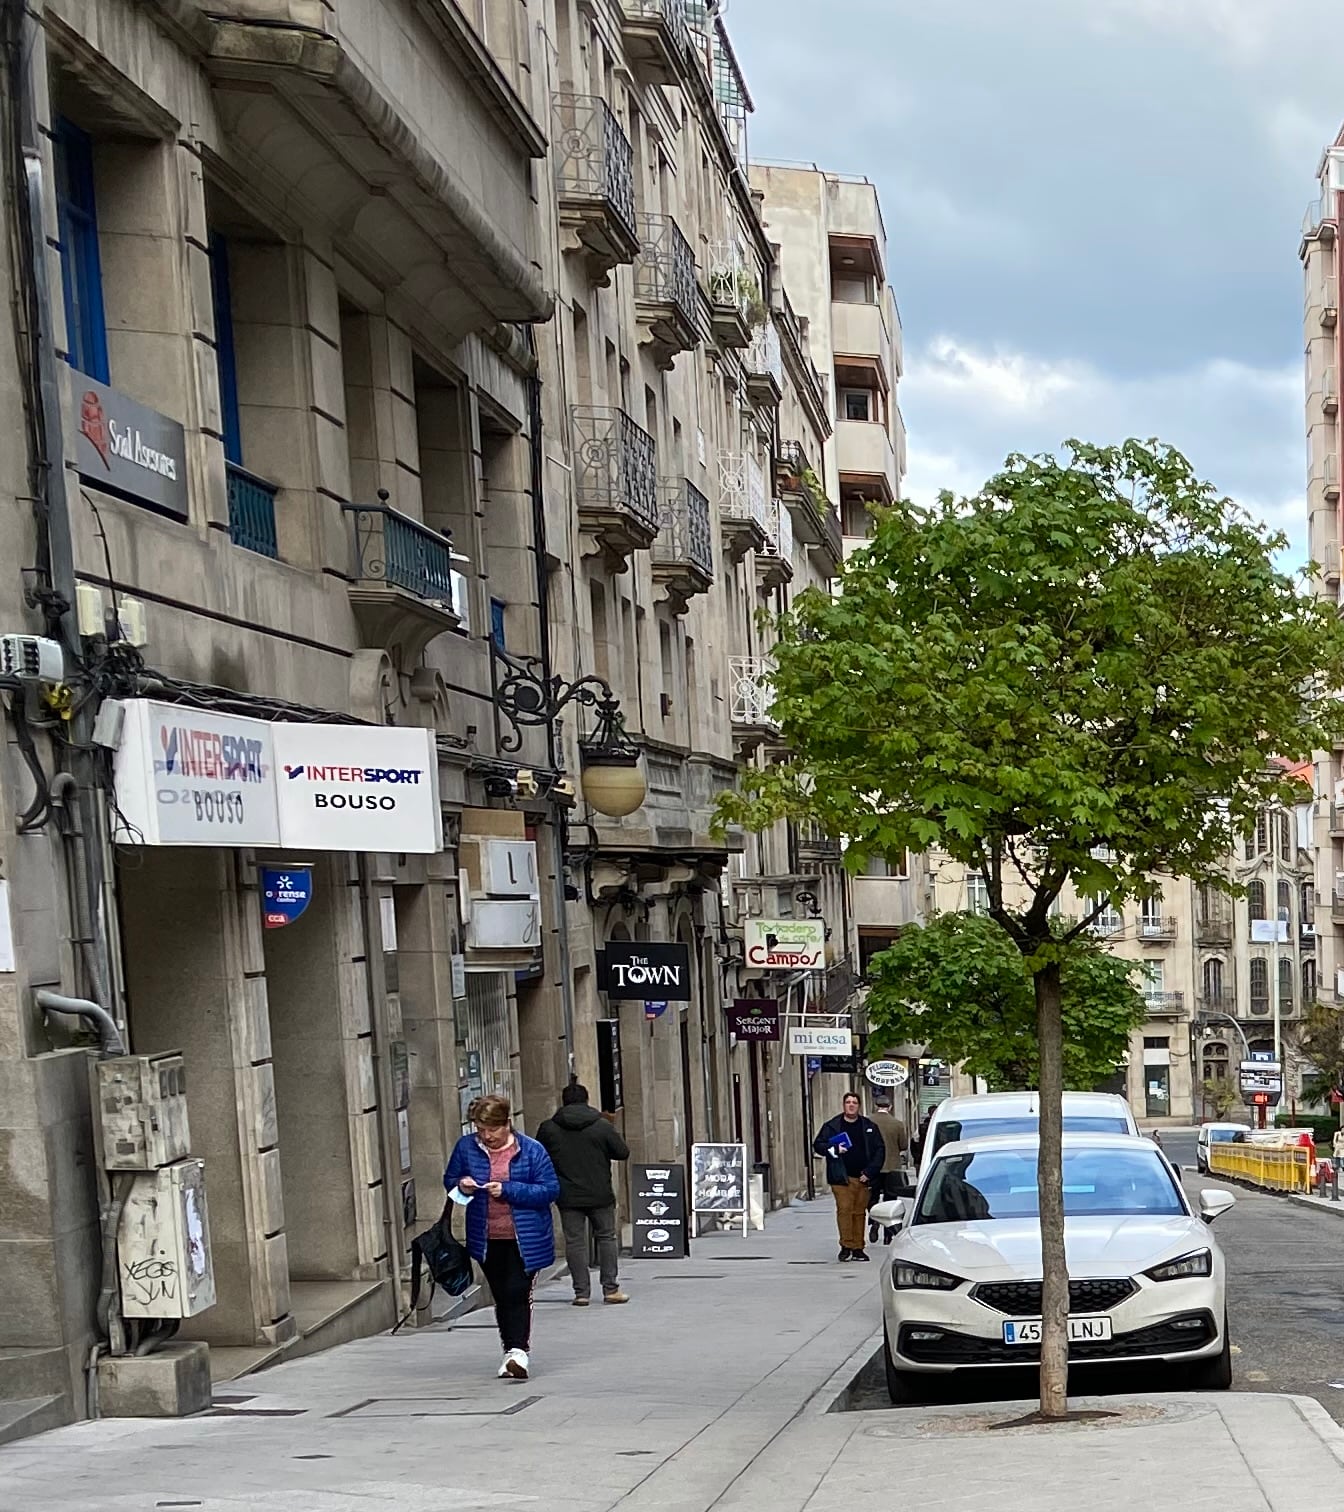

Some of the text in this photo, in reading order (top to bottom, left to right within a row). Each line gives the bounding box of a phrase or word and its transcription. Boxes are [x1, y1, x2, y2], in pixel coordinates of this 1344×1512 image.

[179, 728, 262, 783] INTERSPORT
[307, 765, 422, 784] INTERSPORT
[193, 790, 244, 824] BOUSO
[314, 793, 396, 811] BOUSO
[630, 955, 649, 966] THE
[749, 945, 822, 968] Campos
[611, 964, 681, 987] TOWN
[794, 1031, 847, 1045] mi casa
[1019, 1322, 1103, 1341] 45 LNJ
